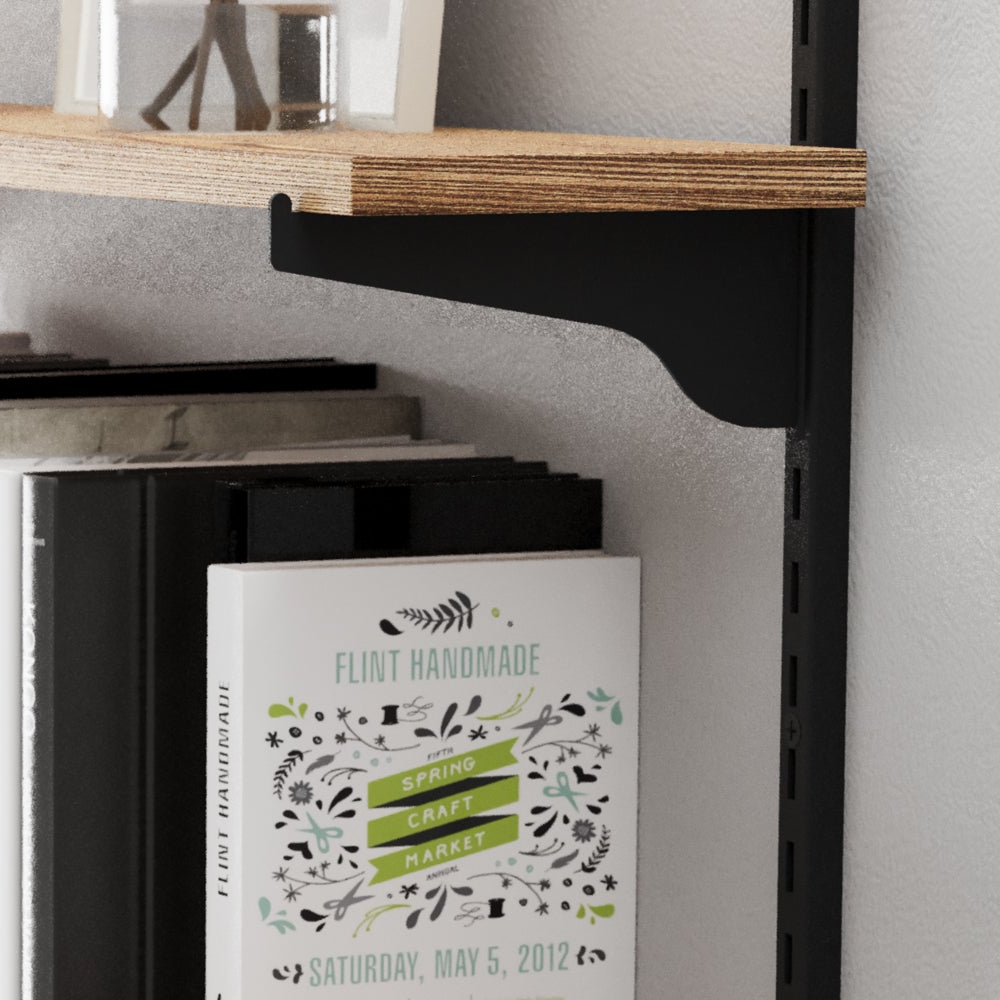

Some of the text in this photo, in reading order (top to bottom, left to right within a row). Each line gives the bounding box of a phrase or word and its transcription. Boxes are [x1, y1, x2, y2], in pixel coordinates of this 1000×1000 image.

[335, 643, 540, 684] FLINT HANDMADE
[427, 747, 454, 761] FIFTH
[217, 682, 231, 898] FLINT HANDMADE
[401, 756, 476, 791] SPRING
[407, 796, 474, 829] CRAFT
[405, 831, 486, 869] MARKET
[426, 865, 460, 881] ANNUAL
[309, 940, 570, 987] SATURDAY, MAY 5, 2012
